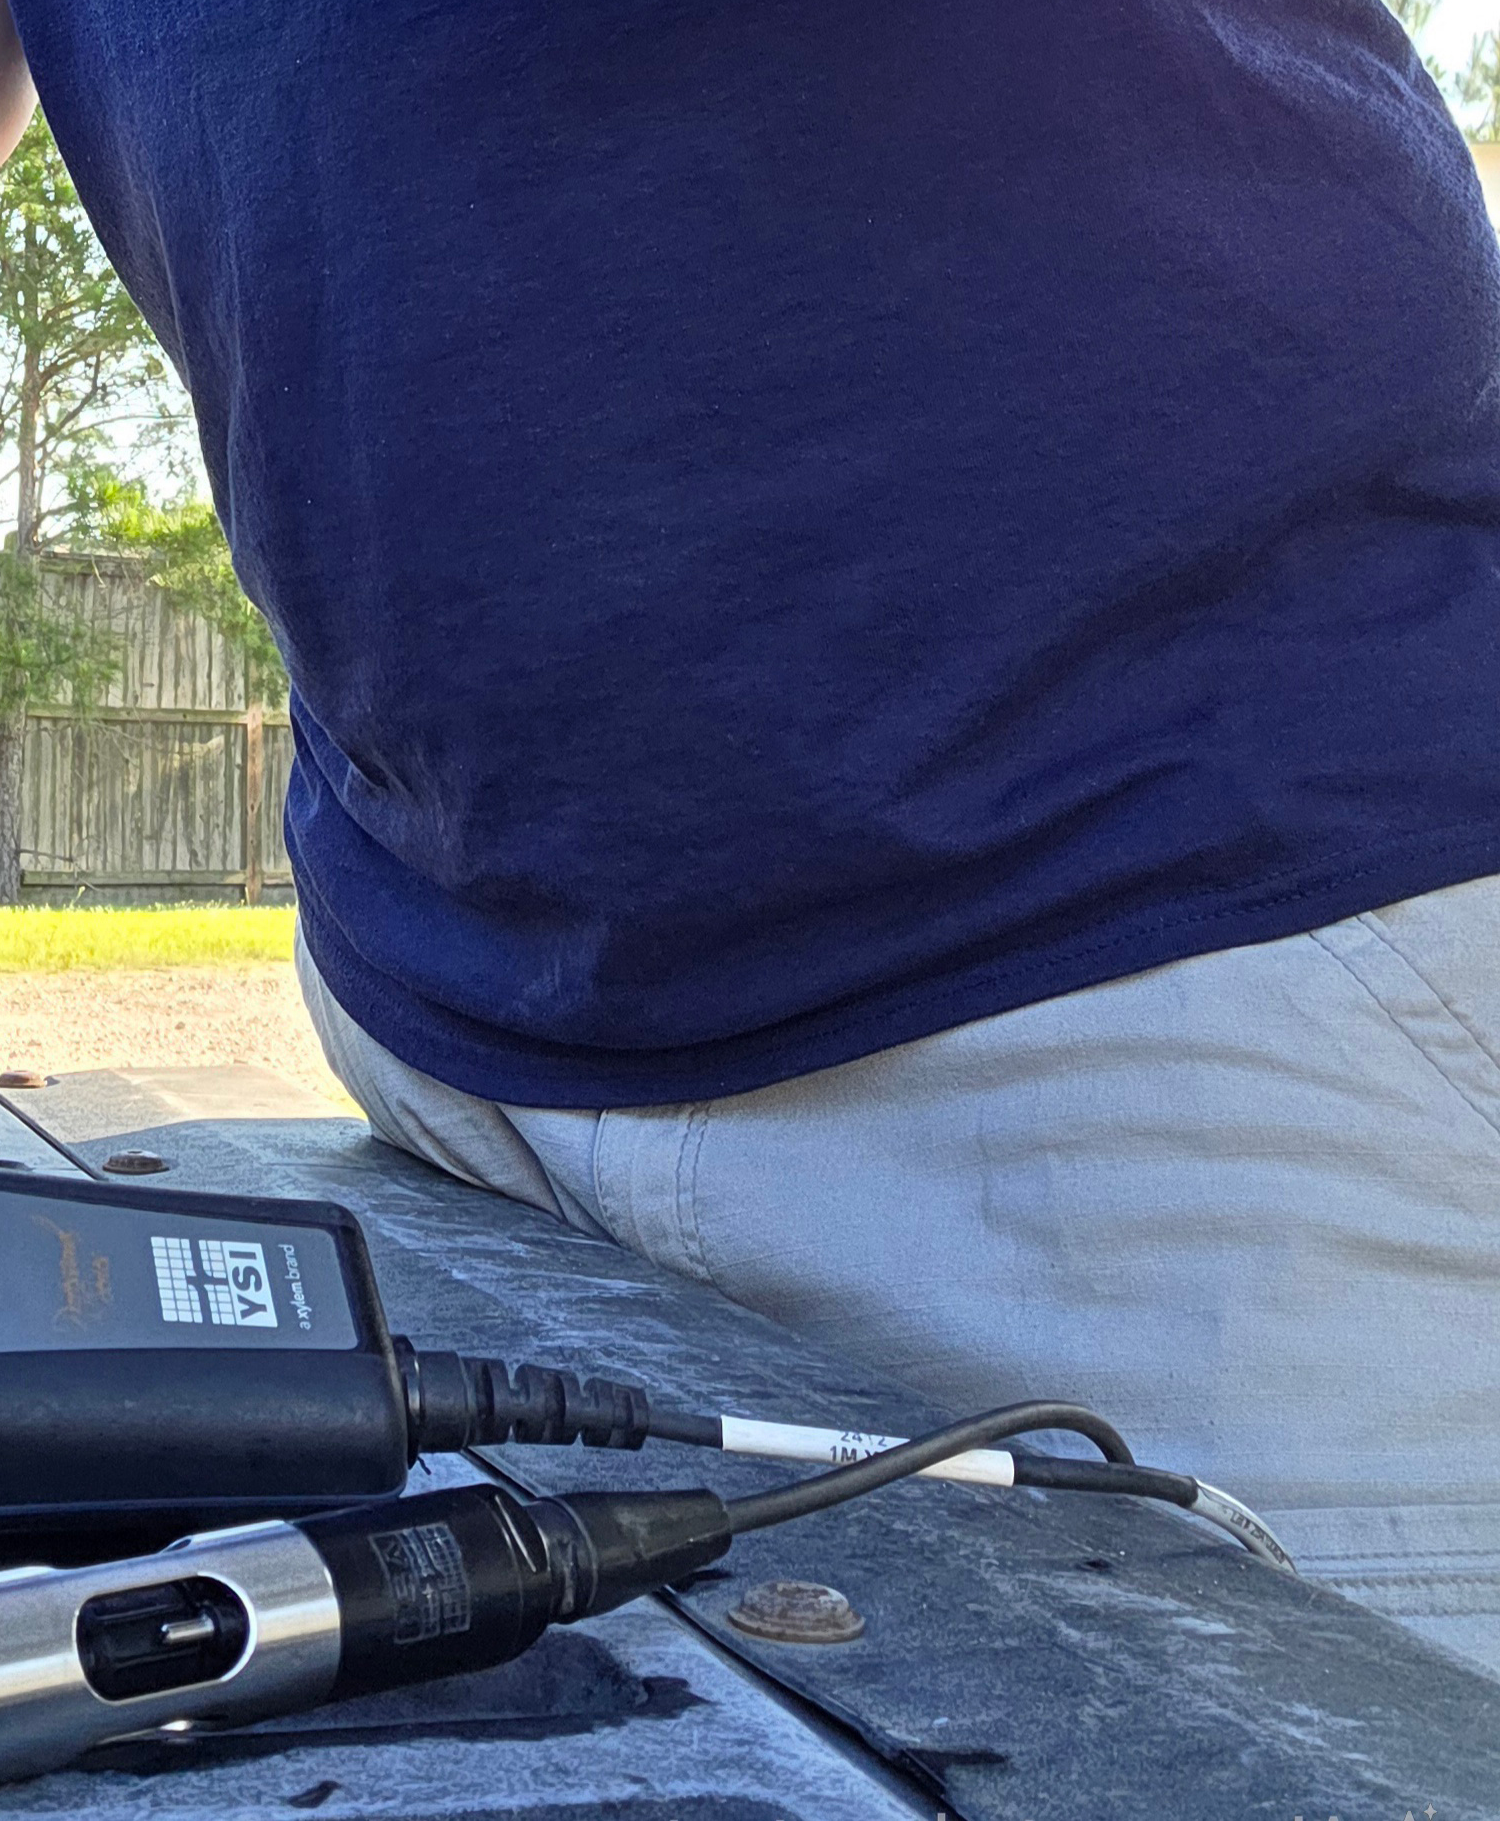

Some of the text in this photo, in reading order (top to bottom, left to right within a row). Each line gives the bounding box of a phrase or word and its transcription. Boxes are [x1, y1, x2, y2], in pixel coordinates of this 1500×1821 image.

[229, 1250, 268, 1320] YSI
[277, 1243, 313, 1330] a xylem brand
